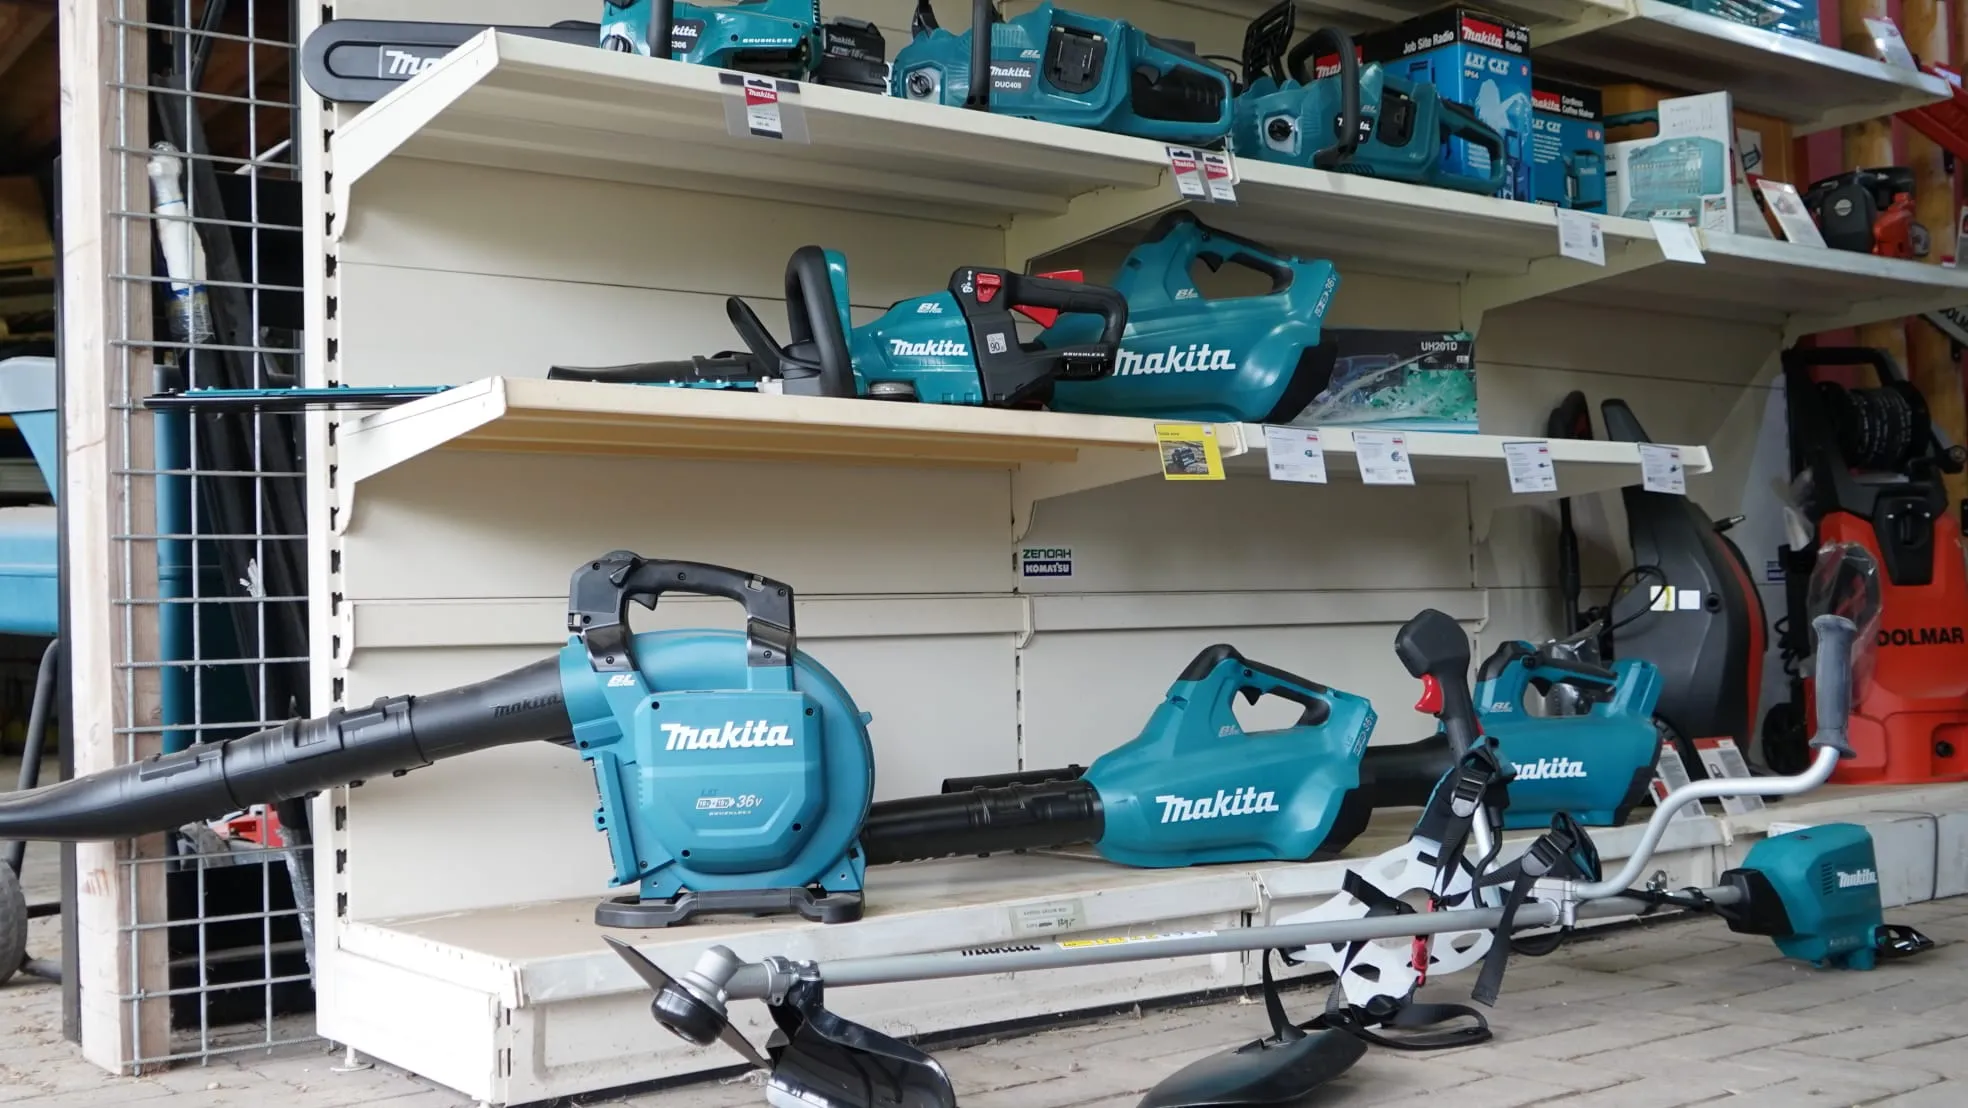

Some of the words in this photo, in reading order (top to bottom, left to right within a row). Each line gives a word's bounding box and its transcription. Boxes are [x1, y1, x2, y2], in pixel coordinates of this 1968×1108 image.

[672, 25, 698, 37] kita
[1462, 25, 1504, 49] Makita
[1403, 41, 1417, 55] Job
[1418, 37, 1432, 50] Site
[1433, 30, 1454, 46] Radio
[990, 65, 1031, 78] Makita
[890, 339, 968, 356] Makita
[1420, 341, 1458, 352] UH201D
[1023, 548, 1072, 559] ZENOAH
[1025, 563, 1070, 574] KOMATSU
[607, 674, 636, 687] BL
[490, 692, 562, 719] Makita
[660, 720, 794, 751] Makita
[1155, 786, 1279, 824] Makita
[1837, 868, 1878, 889] Makita
